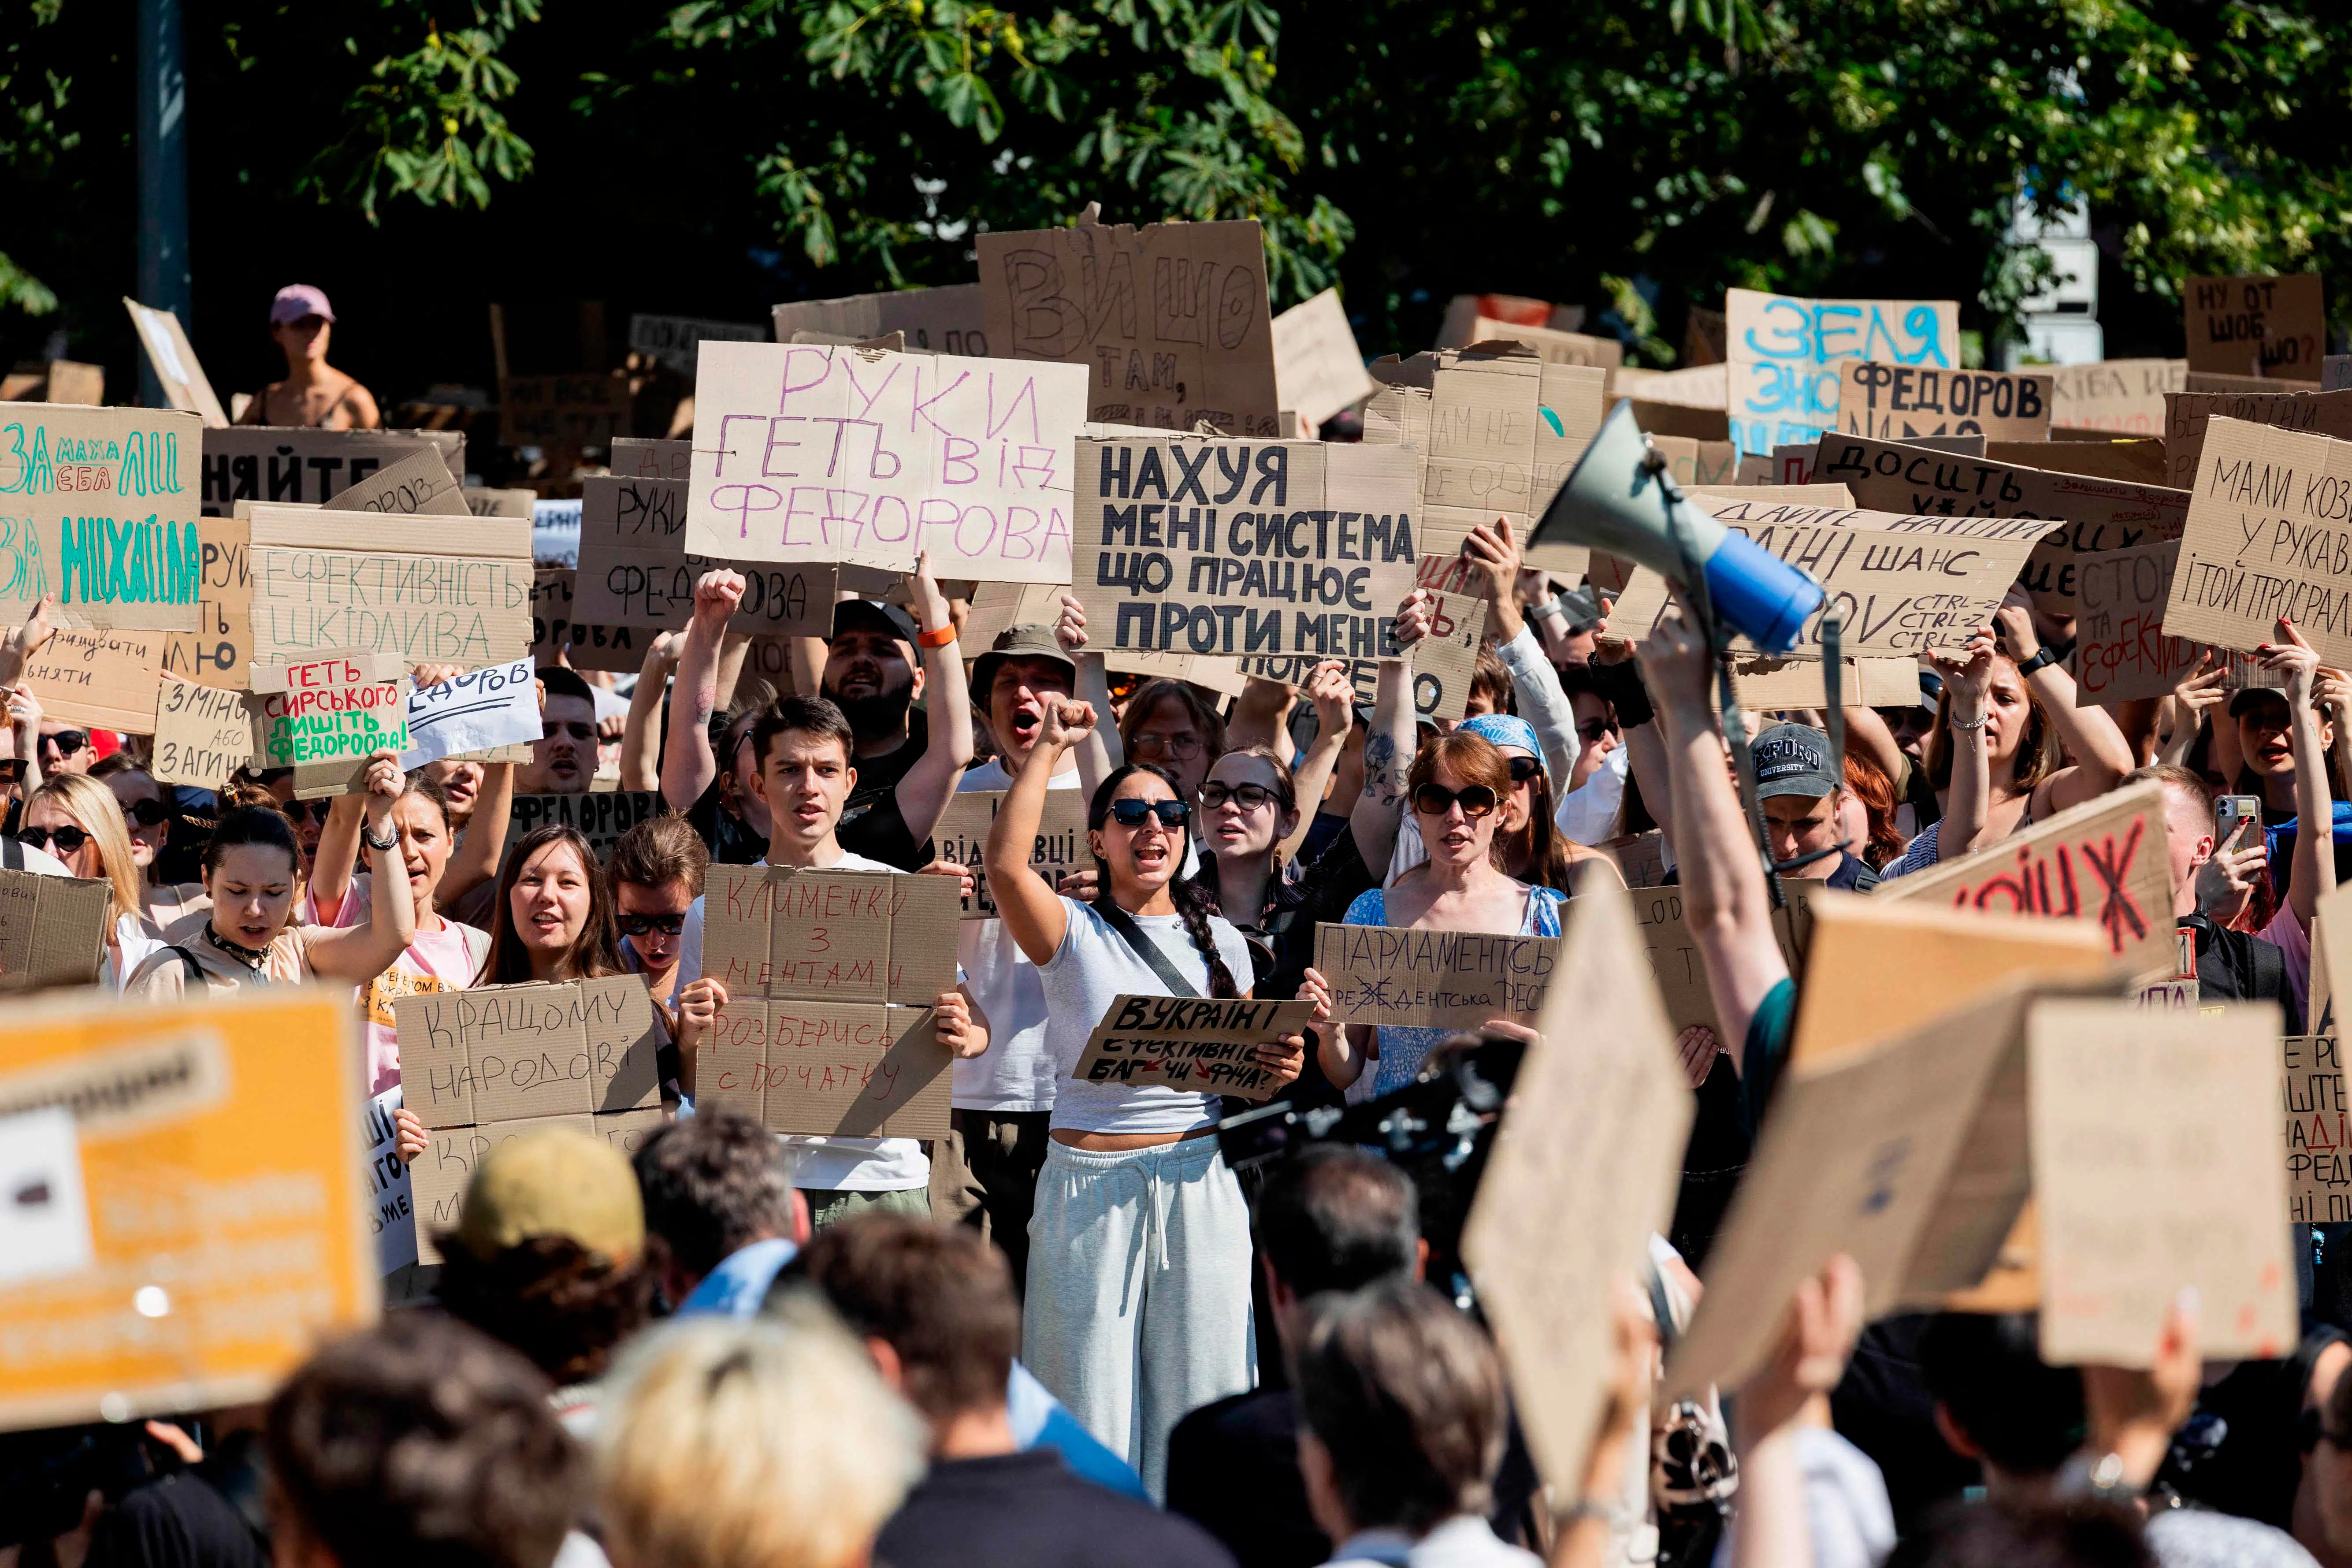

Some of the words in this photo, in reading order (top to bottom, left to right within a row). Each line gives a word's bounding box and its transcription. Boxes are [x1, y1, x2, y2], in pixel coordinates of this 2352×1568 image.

[2243, 282, 2276, 309] ОТ
[1746, 299, 1949, 367] ЗЕЛЯ
[780, 348, 1040, 444] РУКИ
[1096, 345, 1186, 404] ТАМ,
[1853, 361, 2042, 419] ФЕДОРОВ
[715, 414, 902, 479] ГЕТЬ
[943, 437, 1055, 490] ВІД
[1100, 445, 1288, 506] НАХУЯ
[1827, 445, 2022, 503] ДОСИТЬ
[2210, 457, 2292, 511] МАЛИ
[710, 484, 1074, 564] ФЕДОРОВА
[1101, 504, 1216, 553] МЕНІ
[1229, 510, 1415, 564] СИСТЕМА
[1712, 502, 1876, 527] ДАЙТЕ
[1861, 545, 1980, 576] ШАНС
[2238, 512, 2266, 556] У
[2270, 519, 2352, 576] РУКАВ
[267, 551, 524, 610] ЕФЕКТИВНІСТЬ
[607, 566, 807, 621] ФЕДОВА
[1097, 551, 1173, 596] ЩО
[1188, 557, 1373, 611] ПРАЦЮЄ
[1914, 593, 1999, 612] CTRL-Z
[2246, 573, 2352, 639] ПРОСРАЛ
[271, 606, 490, 660] ШКІДЛИВА
[1115, 602, 1281, 654] ПРОТИ
[1295, 610, 1404, 658] МЕНЕ
[1900, 611, 1984, 629] CTRL-Z
[2087, 610, 2111, 639] ТА
[264, 684, 397, 718] СИРСЬКОГО
[287, 660, 361, 688] ГЕТЬ
[209, 729, 244, 749] АБО
[269, 710, 379, 739] ЛИШІТЬ
[1761, 763, 1804, 777] UNIVERSITY
[727, 875, 908, 923] КЛИМЕНКО
[806, 927, 831, 952] З
[725, 957, 902, 989] МЕНТАМИ
[424, 990, 627, 1049] КРАЩОМУ
[429, 1036, 630, 1104] НАРОДОВІ
[1088, 1058, 1147, 1080] БАГ
[1164, 1059, 1192, 1080] ЧИ
[1209, 1060, 1272, 1090] ФІЧА?
